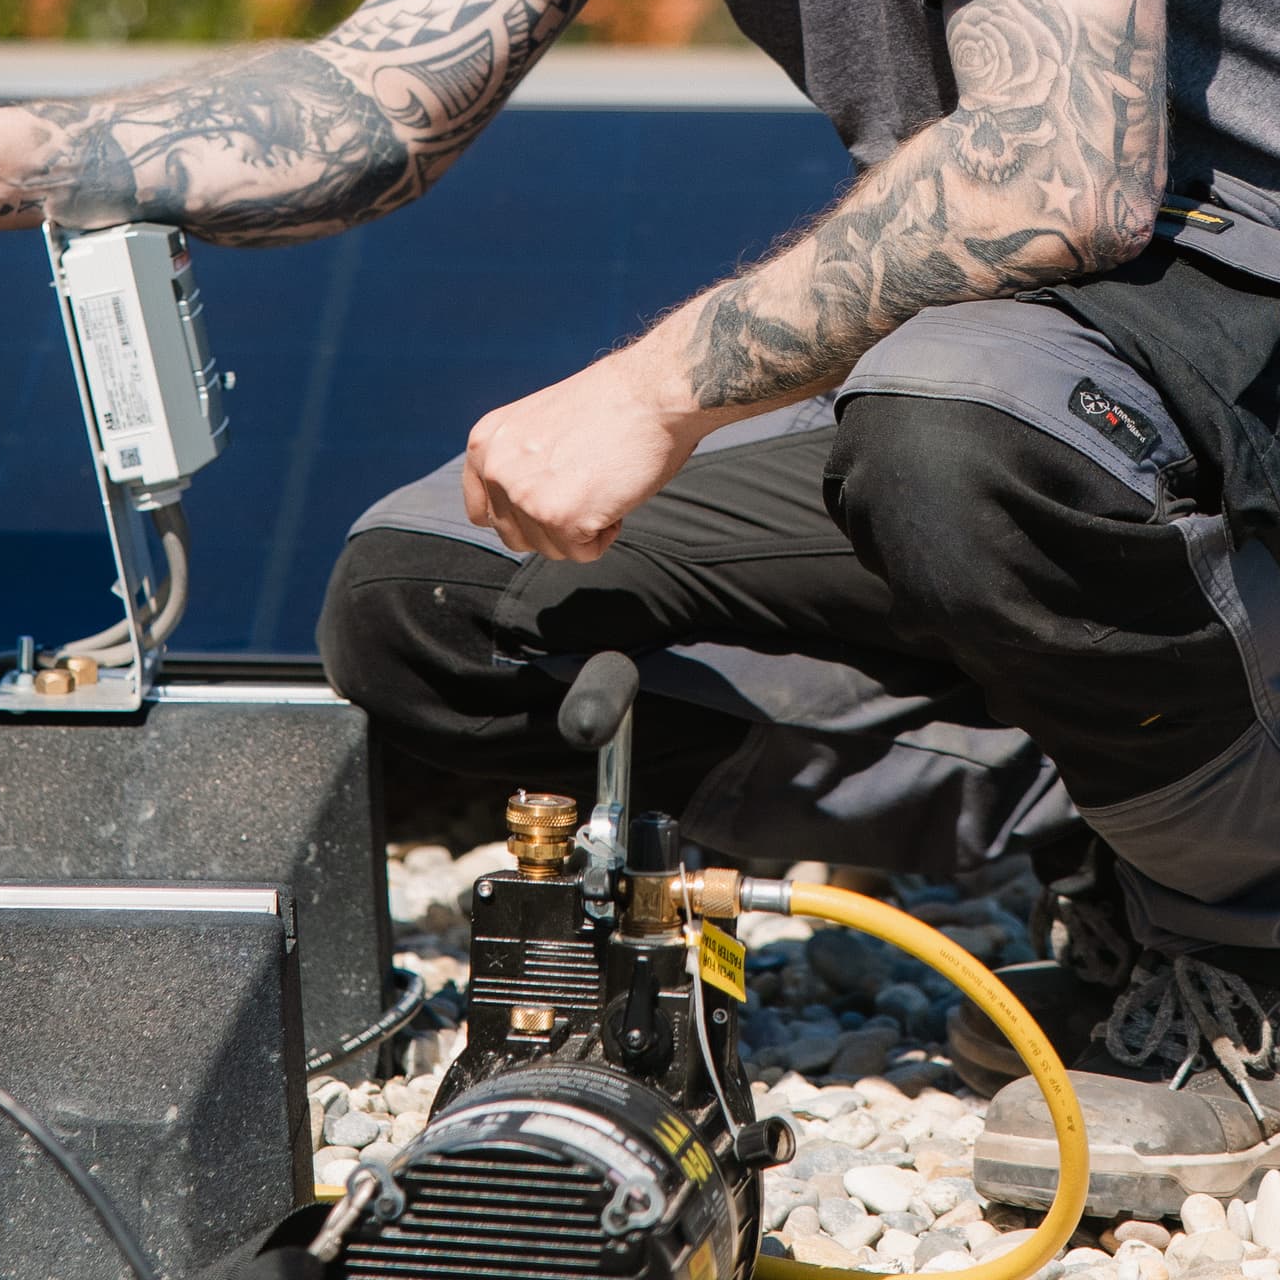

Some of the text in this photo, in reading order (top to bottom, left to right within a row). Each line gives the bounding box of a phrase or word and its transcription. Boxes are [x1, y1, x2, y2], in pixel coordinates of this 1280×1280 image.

[1112, 405, 1146, 443] KneeGuard
[703, 953, 716, 972] FOR
[717, 944, 742, 970] FASTER
